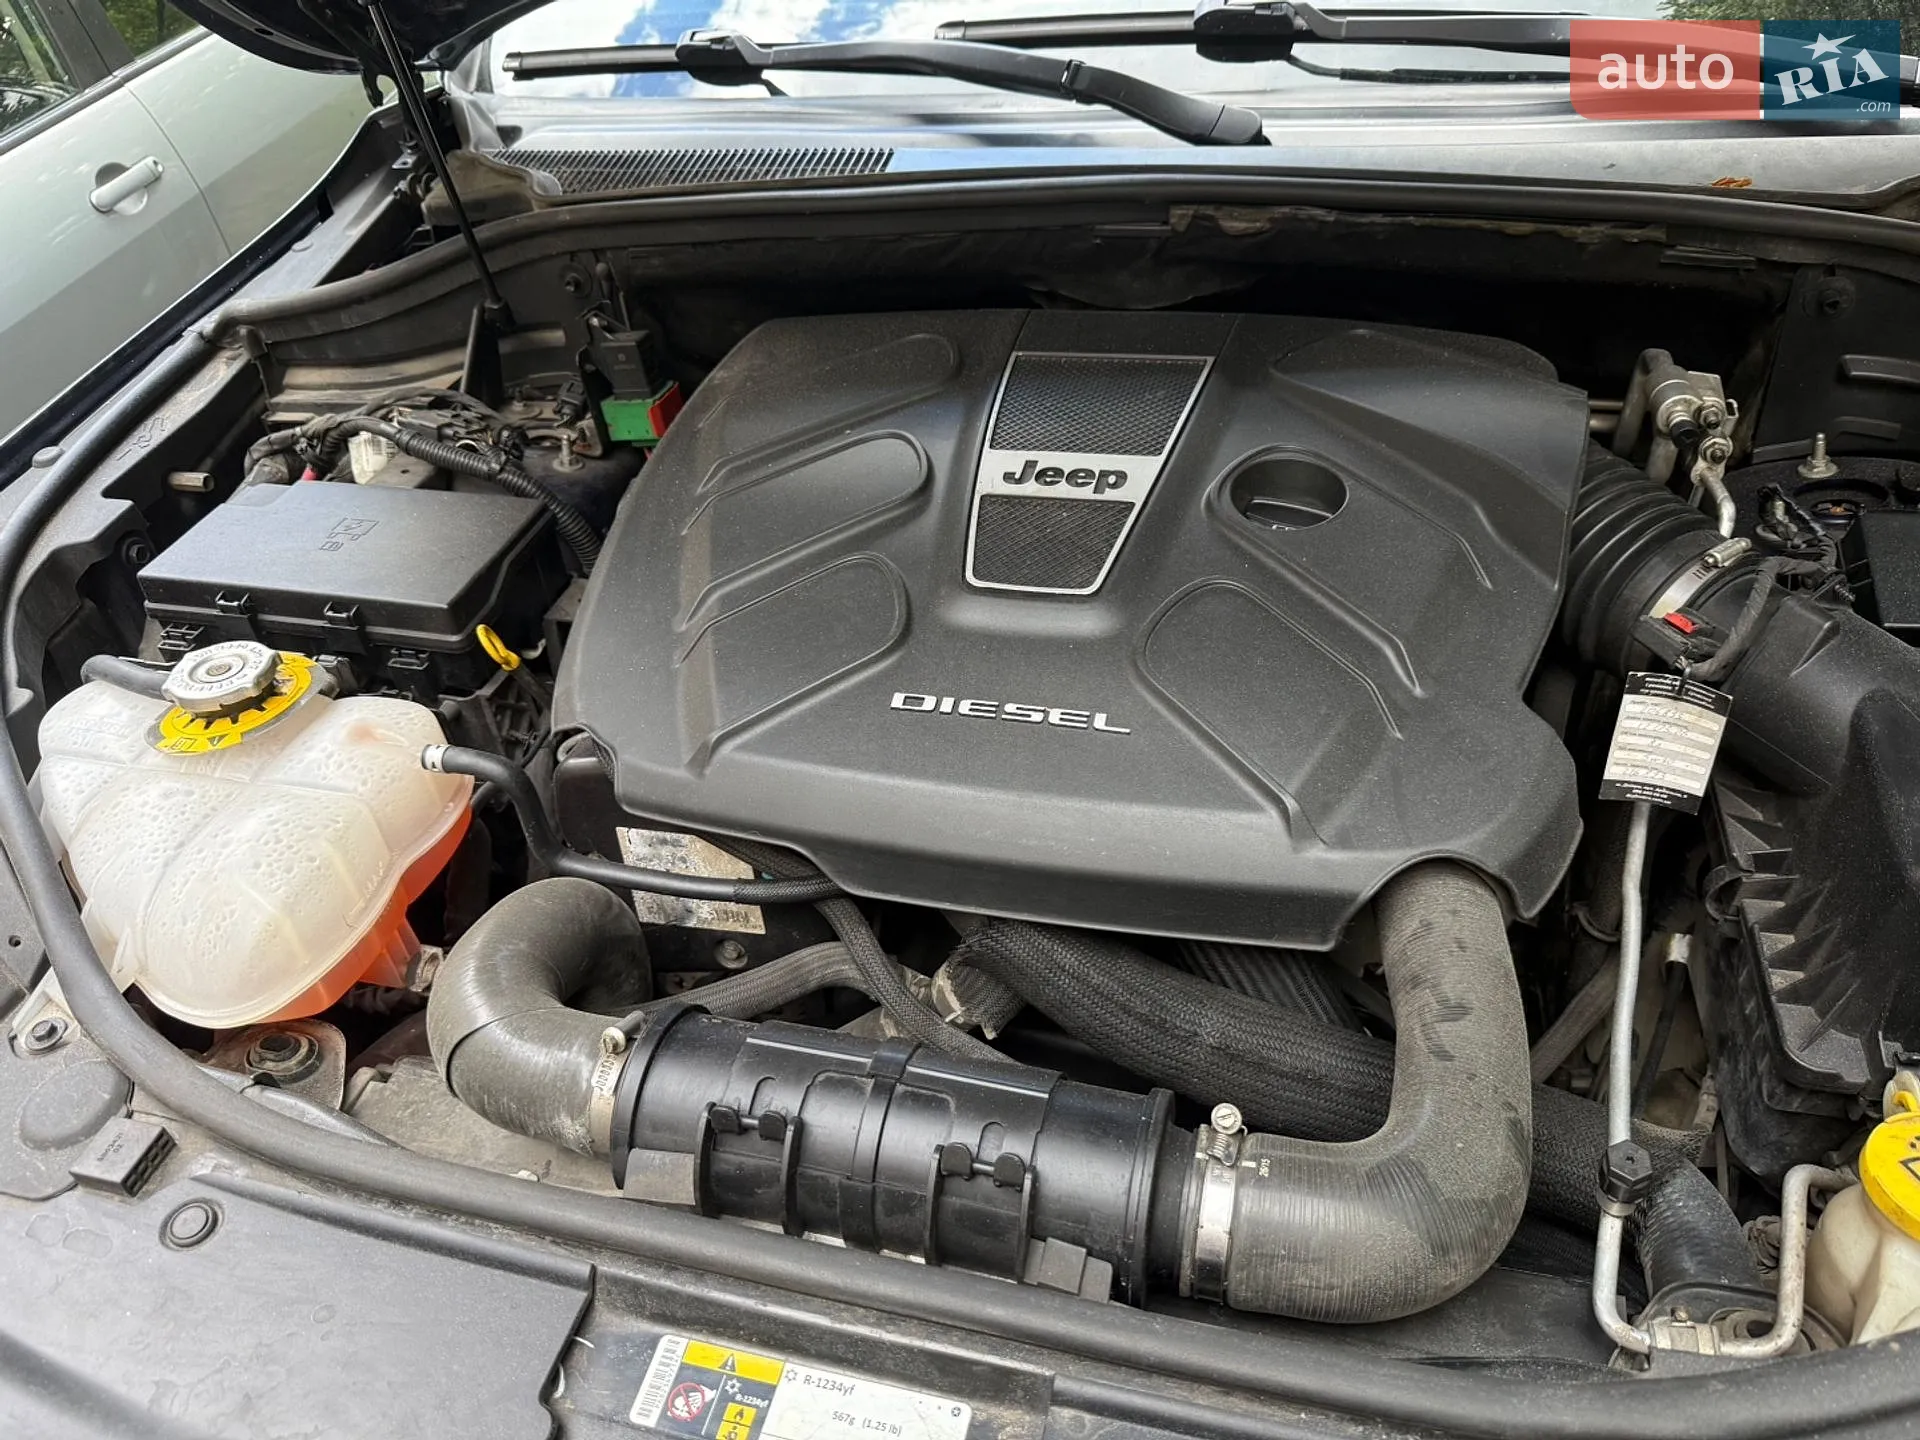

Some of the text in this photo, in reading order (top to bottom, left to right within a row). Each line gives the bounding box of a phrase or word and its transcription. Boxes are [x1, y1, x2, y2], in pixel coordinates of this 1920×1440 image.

[1003, 460, 1128, 494] Jeep
[890, 692, 1131, 732] DIESEL
[804, 1375, 855, 1396] R-1234yf
[832, 1411, 903, 1437] 567g (1.25 lb)
